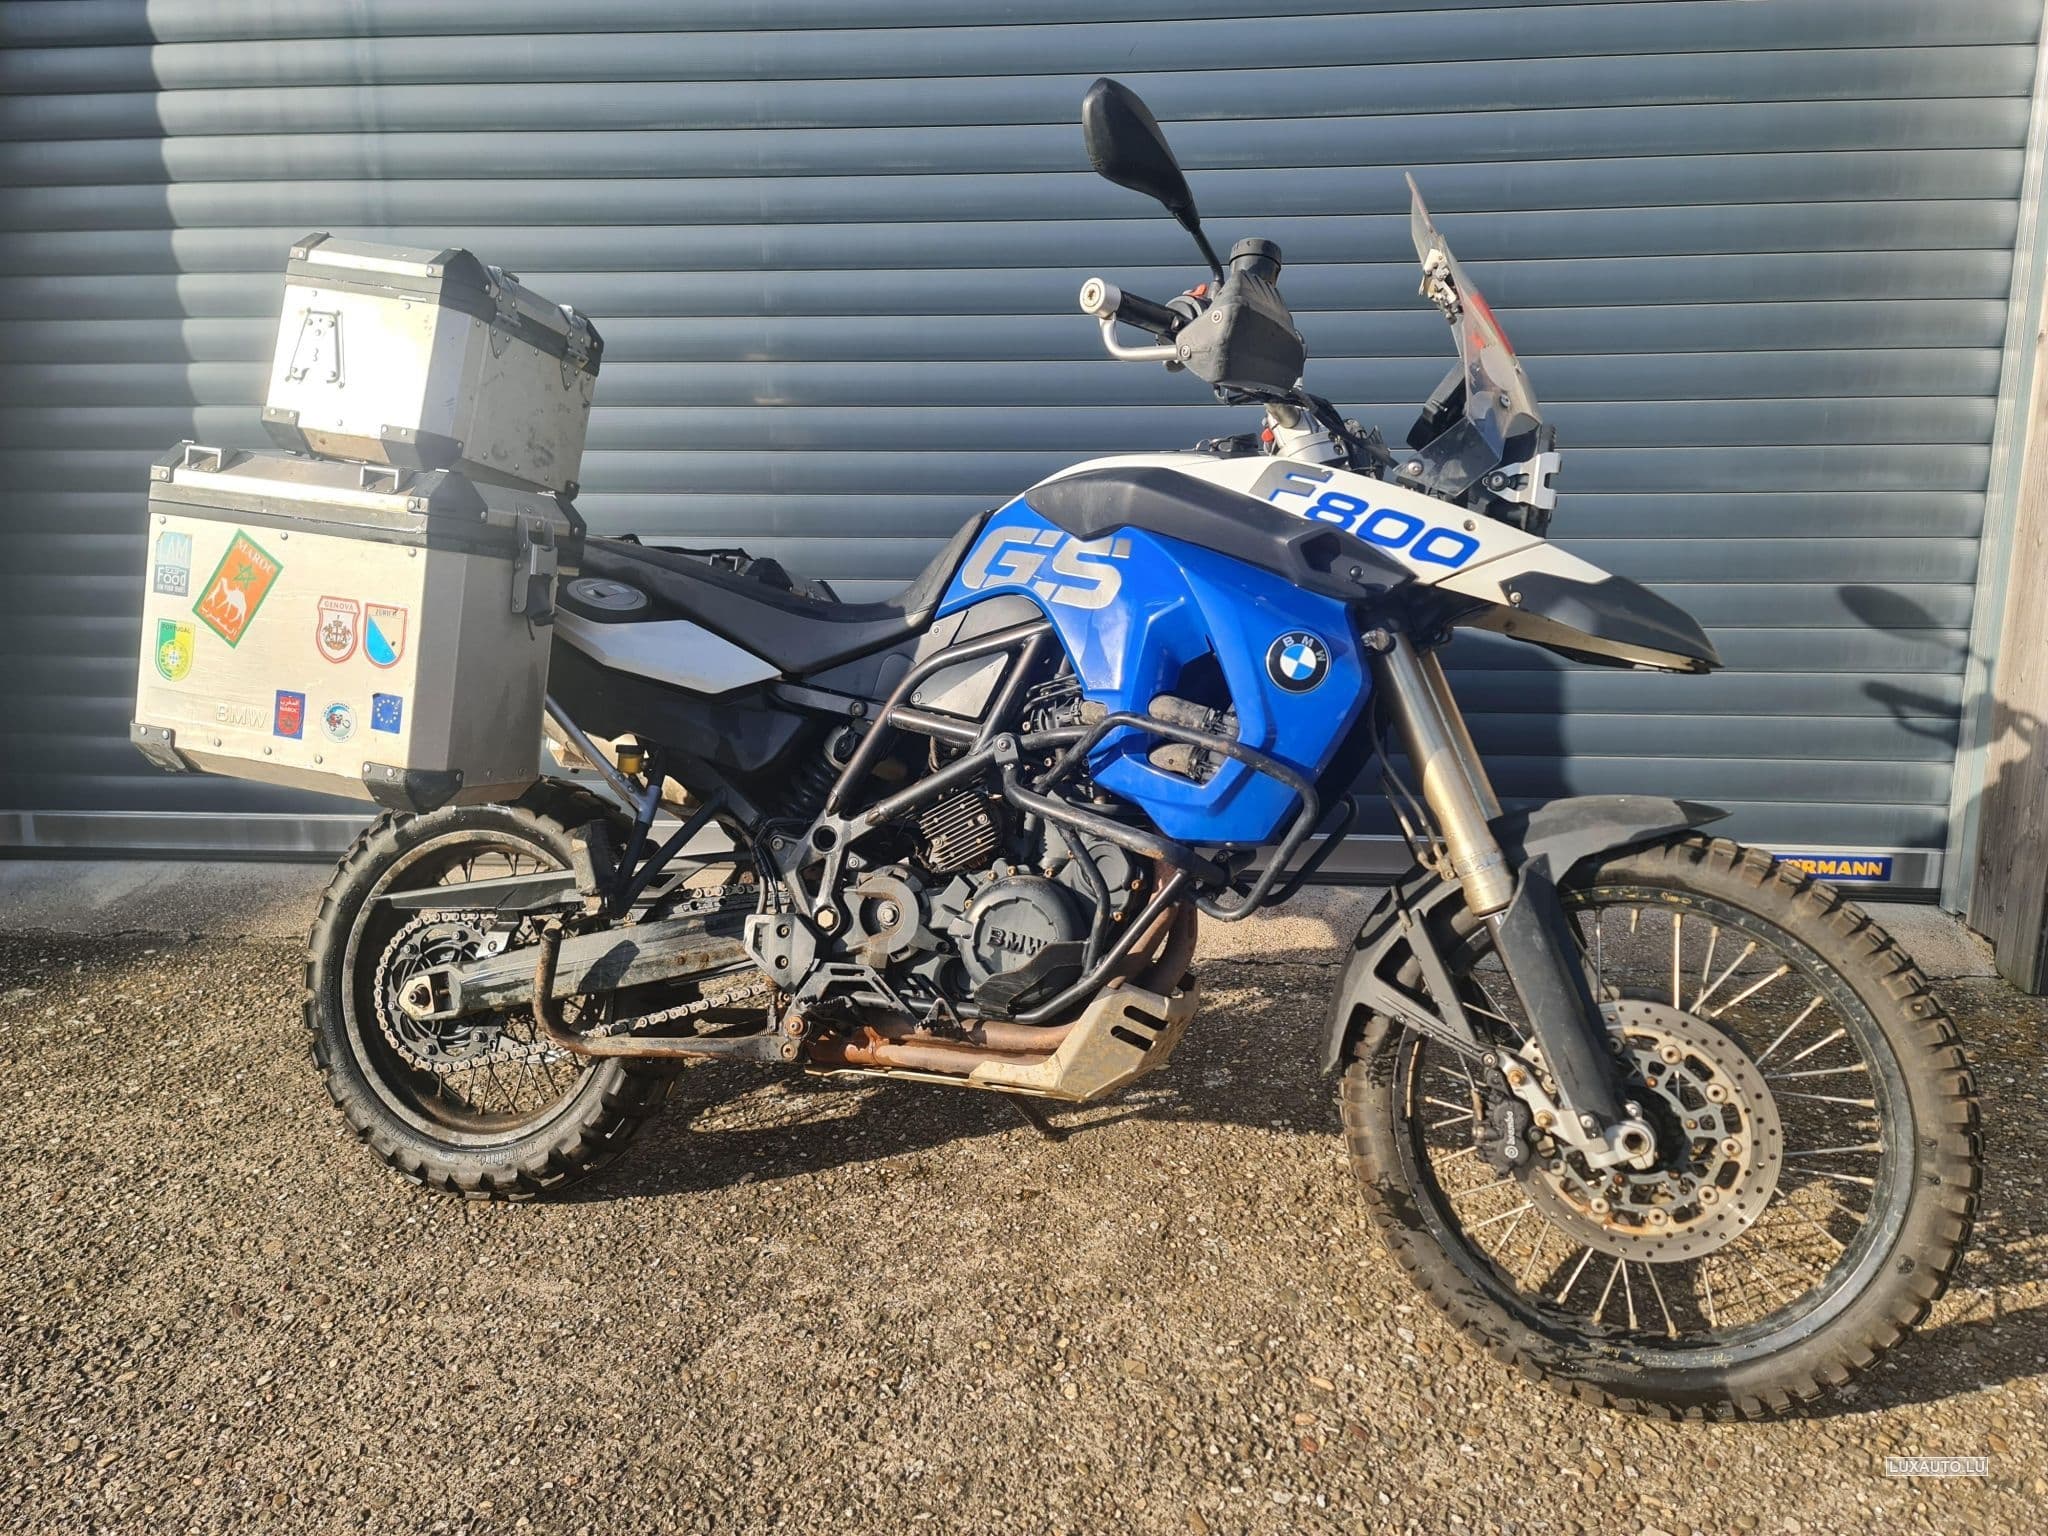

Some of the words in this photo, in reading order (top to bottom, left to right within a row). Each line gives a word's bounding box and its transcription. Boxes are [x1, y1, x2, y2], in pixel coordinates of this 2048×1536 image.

[237, 538, 274, 574] MAROC
[961, 526, 1132, 610] GS
[323, 600, 354, 611] GENOVA
[1282, 635, 1326, 662] BMW
[215, 702, 268, 728] BMW
[1779, 859, 1882, 875] RMANN
[987, 926, 1048, 956] BMW
